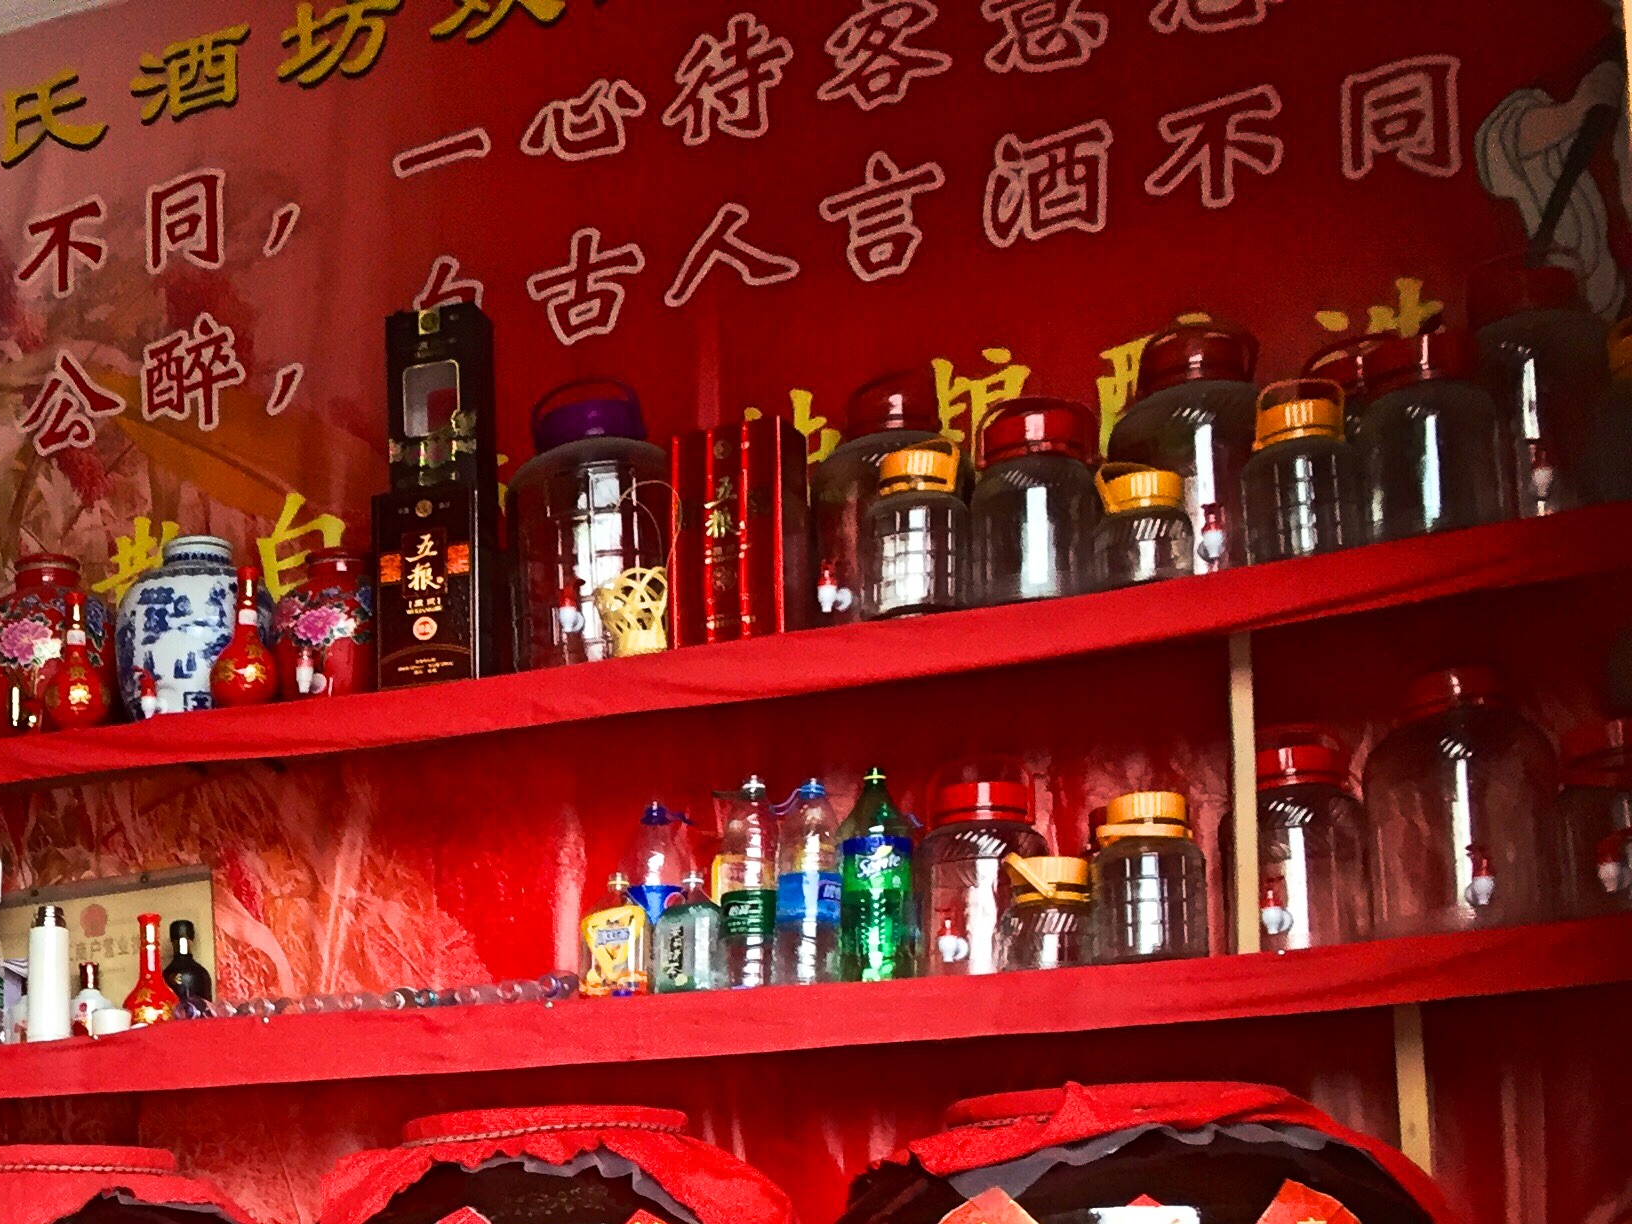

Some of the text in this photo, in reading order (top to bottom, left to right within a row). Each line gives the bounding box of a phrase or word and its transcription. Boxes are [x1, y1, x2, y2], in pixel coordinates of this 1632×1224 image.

[393, 0, 1266, 178] 一心待客意
